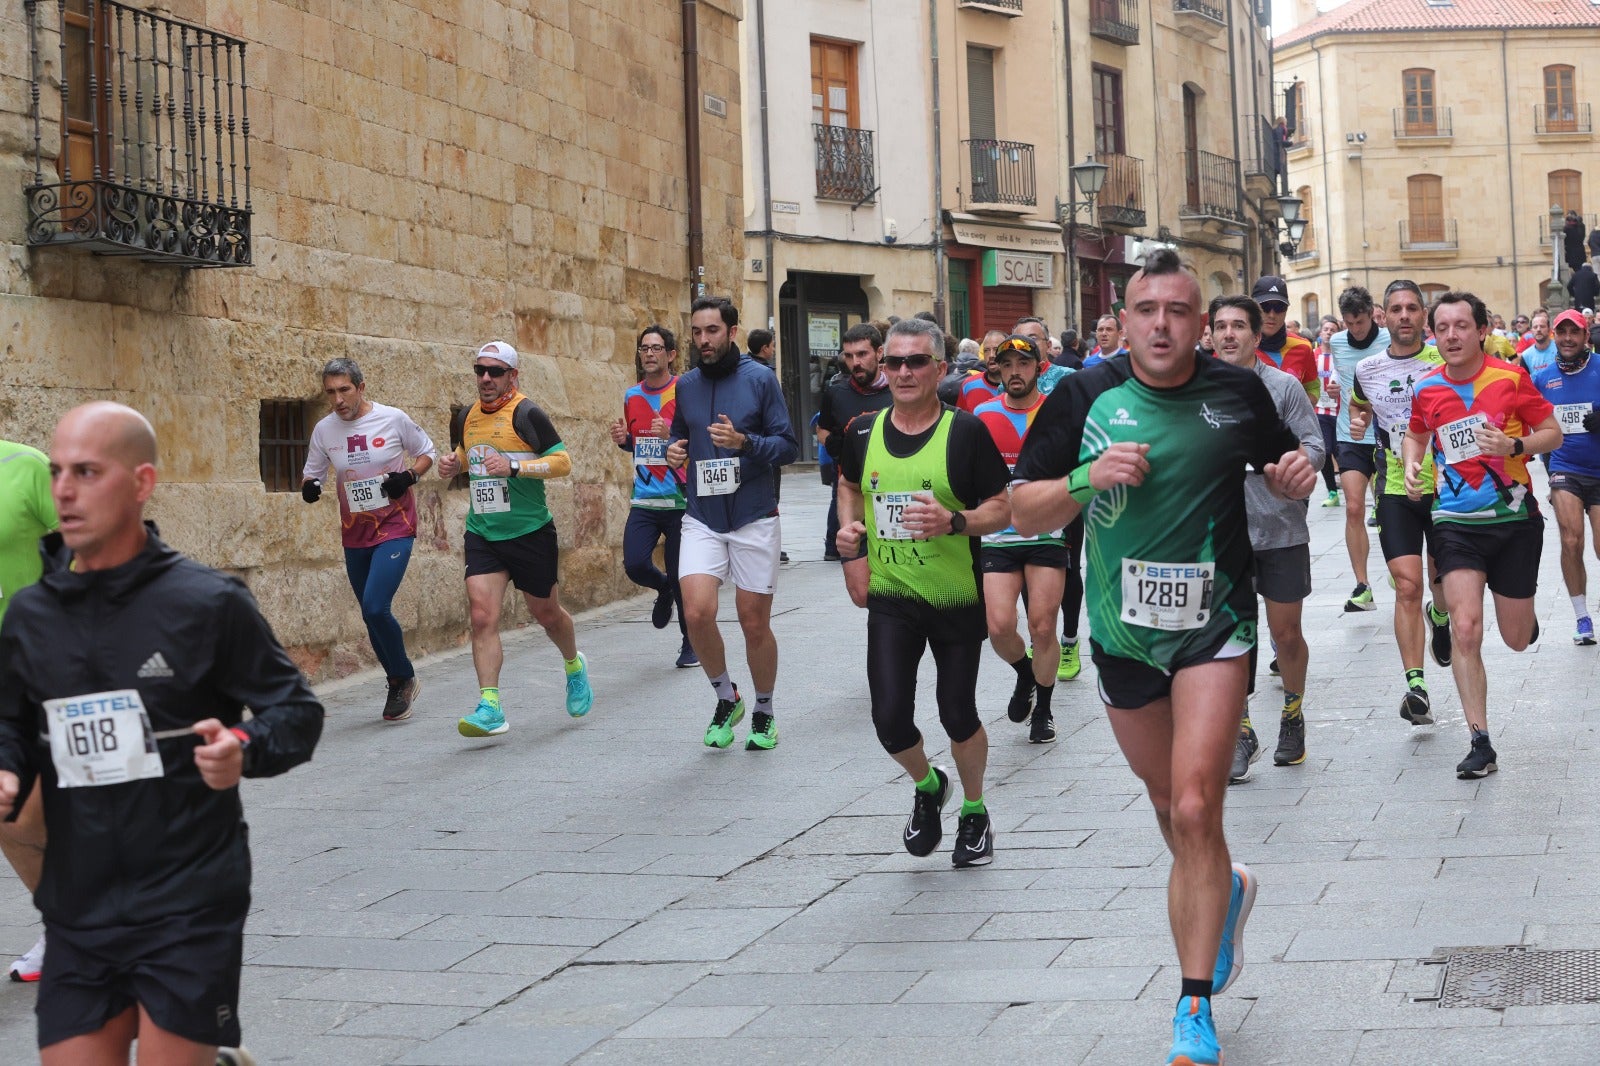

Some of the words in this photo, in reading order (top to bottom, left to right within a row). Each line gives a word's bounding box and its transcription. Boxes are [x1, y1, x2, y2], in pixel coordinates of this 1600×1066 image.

[970, 231, 986, 240] away
[1004, 260, 1044, 282] SCALE
[1449, 416, 1482, 432] SETEL
[1562, 412, 1580, 424] 498
[1449, 428, 1476, 449] 823
[640, 444, 662, 456] 3473
[706, 460, 736, 468] SETEL
[352, 480, 380, 488] SETEL
[703, 468, 728, 484] 1346
[352, 487, 372, 502] 336
[476, 488, 494, 502] 953
[886, 504, 908, 523] 73
[878, 544, 926, 566] GUA
[1146, 566, 1204, 578] SETEL
[1138, 579, 1188, 607] 1289
[65, 696, 139, 718] SETEL
[65, 718, 118, 757] 1618
